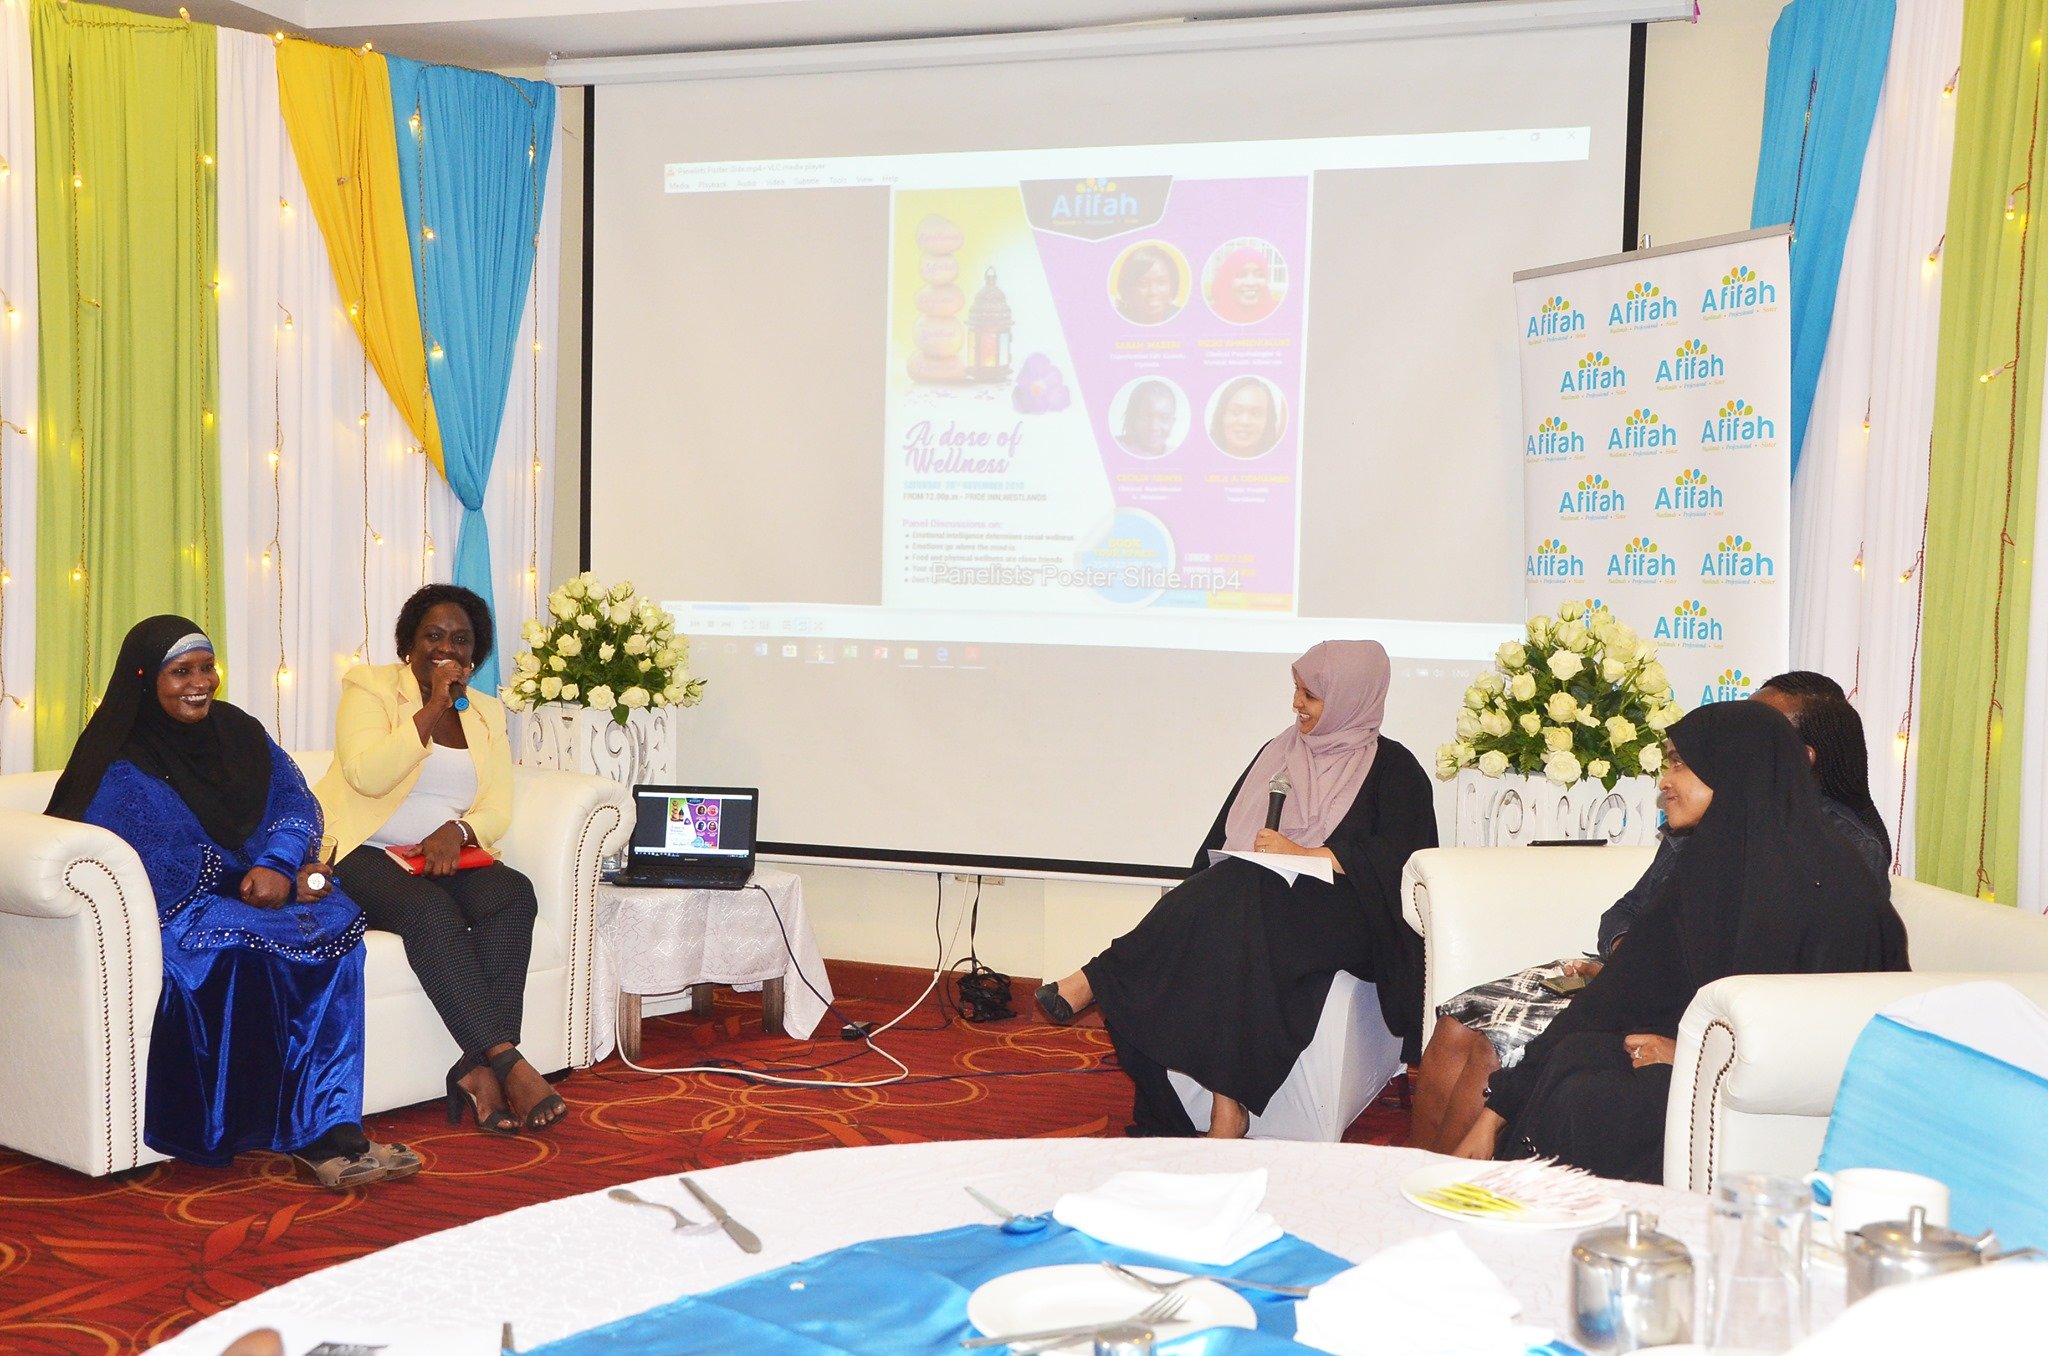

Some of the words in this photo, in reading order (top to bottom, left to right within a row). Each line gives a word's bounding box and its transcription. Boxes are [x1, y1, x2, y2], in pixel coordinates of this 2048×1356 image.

[1702, 280, 1775, 313] Afifah
[1608, 295, 1677, 326] Afifah
[1527, 310, 1585, 338] Afifah
[1560, 365, 1626, 393] Afifah
[1655, 354, 1724, 383] Afifah
[902, 420, 933, 450] A
[939, 420, 992, 446] dose
[996, 420, 1024, 458] of
[1608, 424, 1677, 450] Afifah
[1701, 415, 1775, 444] Afifah
[1526, 431, 1584, 456] Afifah
[905, 447, 1010, 474] Wellness
[1559, 489, 1625, 513] Afifah
[1654, 484, 1723, 510] Afifah
[902, 519, 928, 528] Panel
[930, 519, 986, 529] Discussions
[912, 554, 929, 562] Food
[1526, 554, 1584, 576] Afifah
[1607, 553, 1676, 576] Afifah
[1700, 552, 1774, 576] Afifah
[931, 562, 1033, 585] Panelists
[1041, 564, 1117, 588] Poster
[1123, 566, 1241, 596] Slide.mp4
[1653, 616, 1723, 641] Afifah
[1700, 684, 1757, 706] Afif
